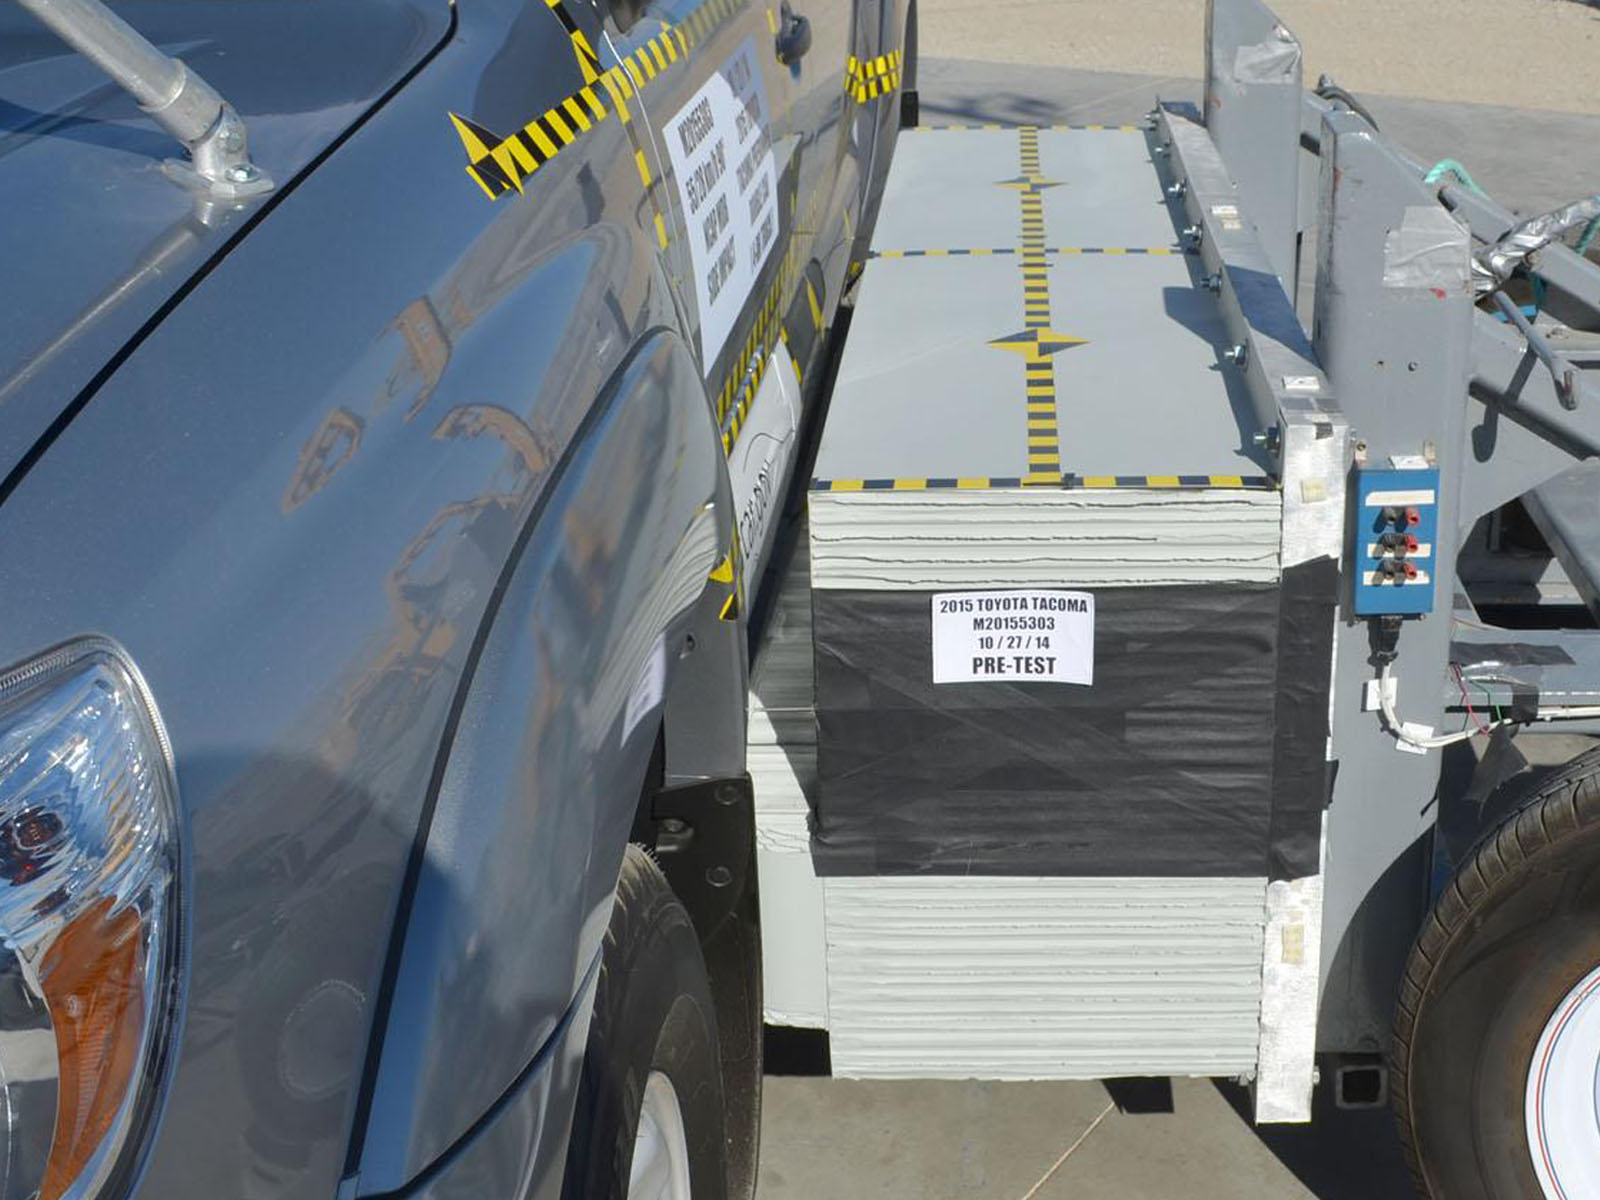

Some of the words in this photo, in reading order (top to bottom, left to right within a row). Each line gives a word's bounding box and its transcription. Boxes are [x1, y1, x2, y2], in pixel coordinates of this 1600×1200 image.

[940, 599, 974, 613] 2015
[977, 597, 1029, 612] TOYOTA
[1032, 597, 1088, 613] TACOMA
[973, 616, 1055, 631] M20155303
[978, 636, 994, 649] 10
[1007, 636, 1022, 649] 27
[1035, 636, 1050, 649] 14
[972, 656, 1057, 675] PRE-TEST
